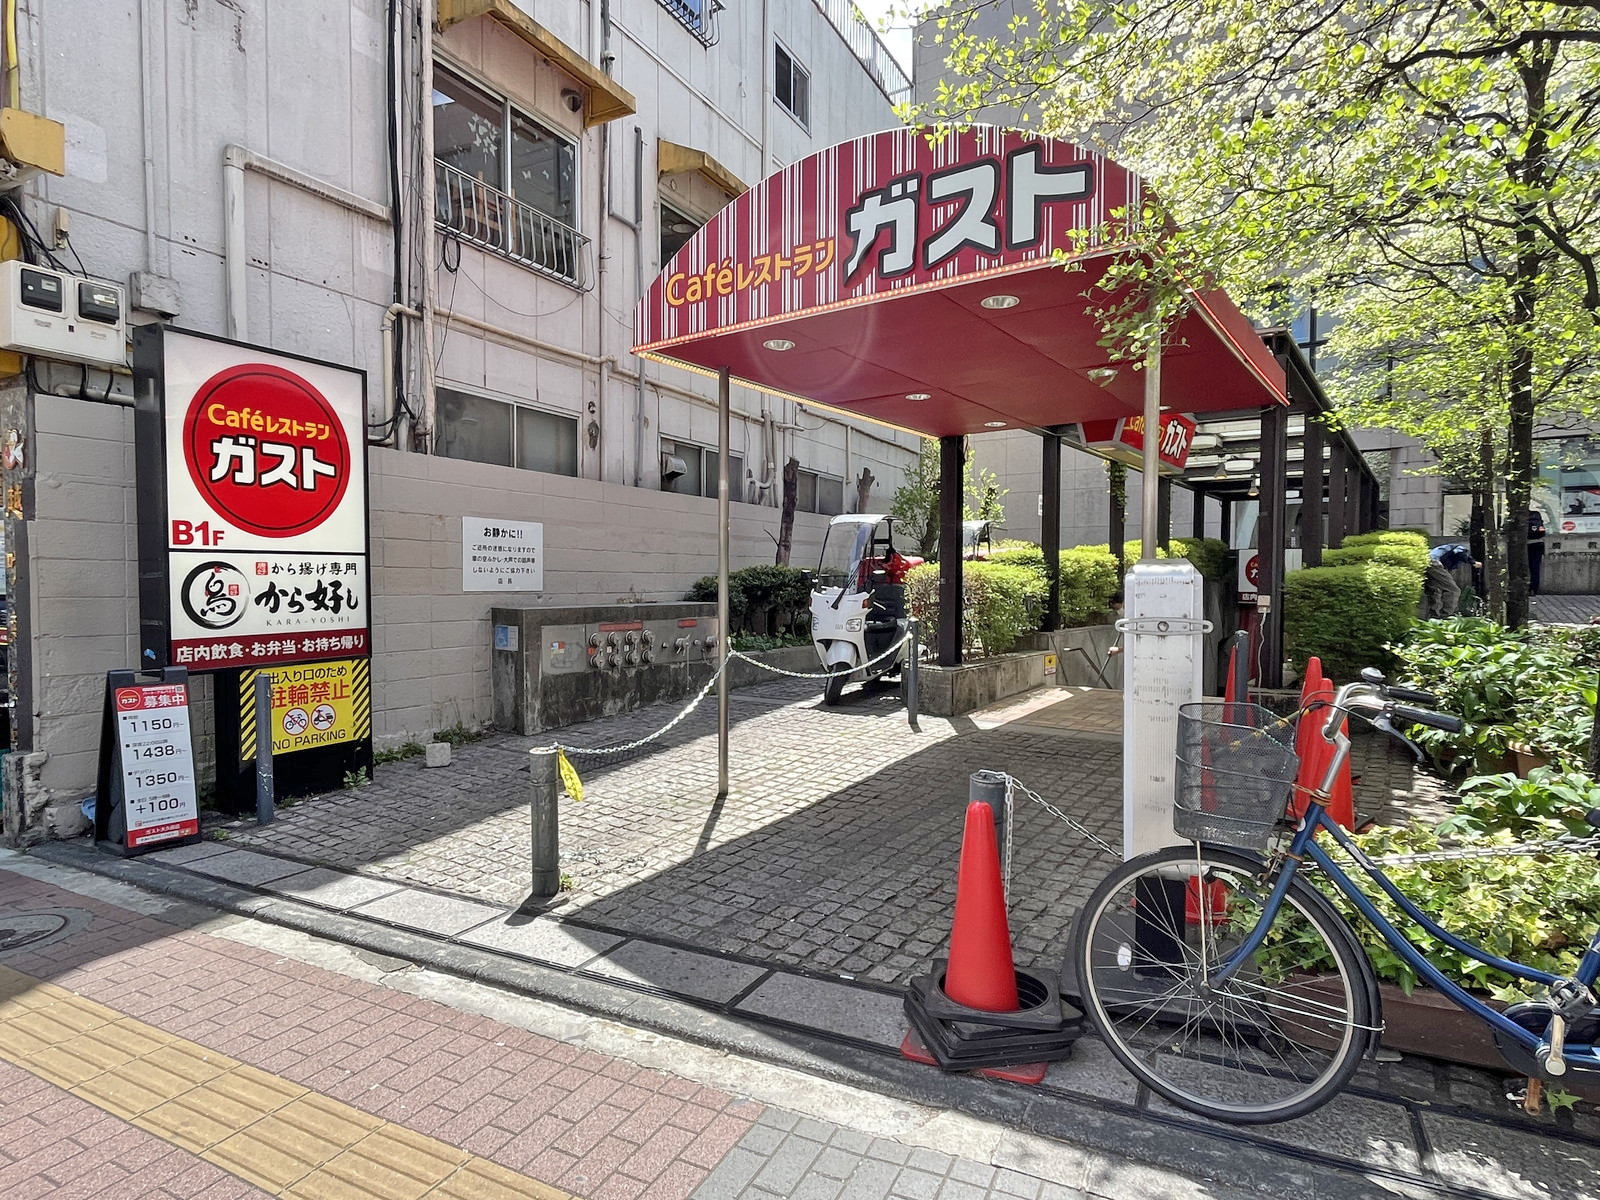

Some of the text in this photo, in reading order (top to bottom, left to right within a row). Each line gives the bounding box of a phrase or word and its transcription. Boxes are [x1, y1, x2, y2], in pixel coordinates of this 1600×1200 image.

[666, 146, 1094, 306] Caféレストラン ガスト
[207, 403, 330, 440] Caféレストラン
[1160, 419, 1188, 459] ガスト
[210, 434, 336, 491] ガスト
[172, 519, 225, 546] B1F
[483, 526, 523, 539] お静かに!!
[271, 561, 358, 576] から揚げ専門
[254, 579, 359, 615] から好し
[266, 616, 351, 627] KARA-YOSHI
[270, 666, 348, 685] 出入り口のため
[144, 693, 185, 708] 募集中
[273, 729, 346, 751] NO PARKING
